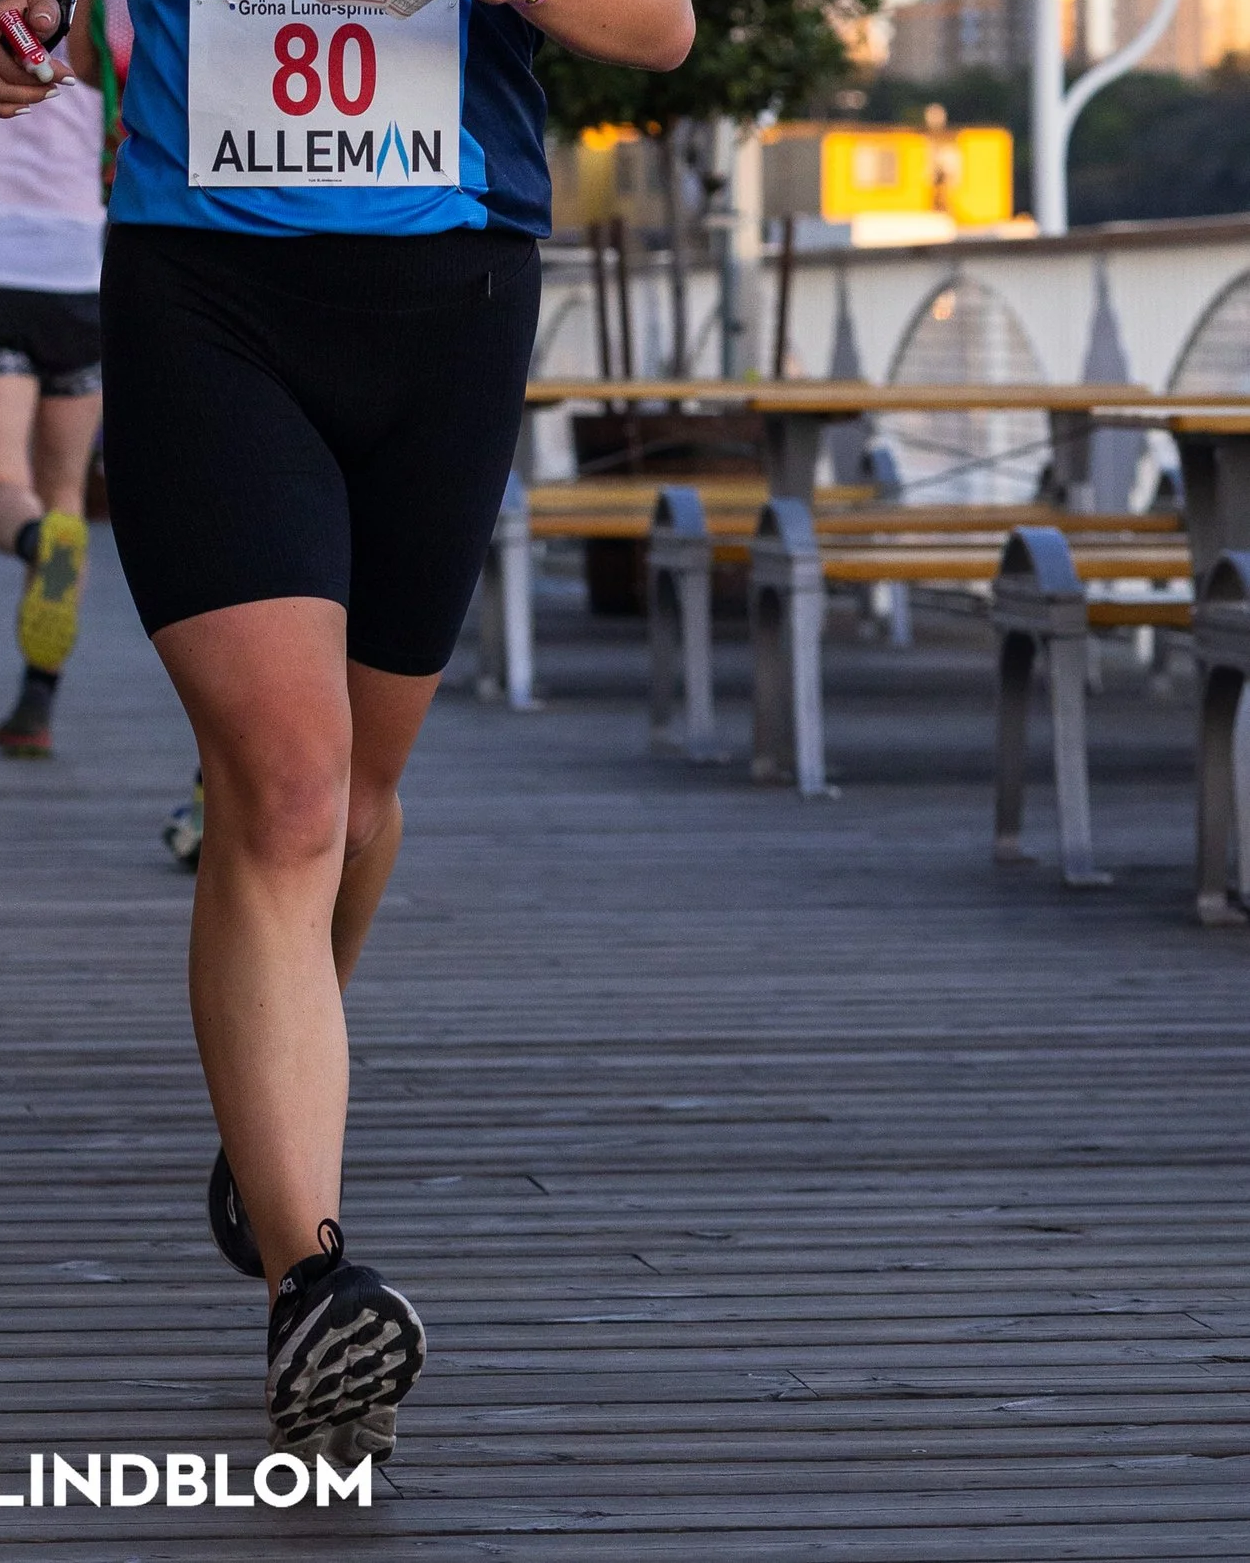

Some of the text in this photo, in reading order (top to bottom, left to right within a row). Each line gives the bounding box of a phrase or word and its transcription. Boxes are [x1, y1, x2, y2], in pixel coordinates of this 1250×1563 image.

[238, 0, 286, 16] Gröna
[272, 22, 377, 117] 80
[211, 120, 441, 182] ALLEMAN
